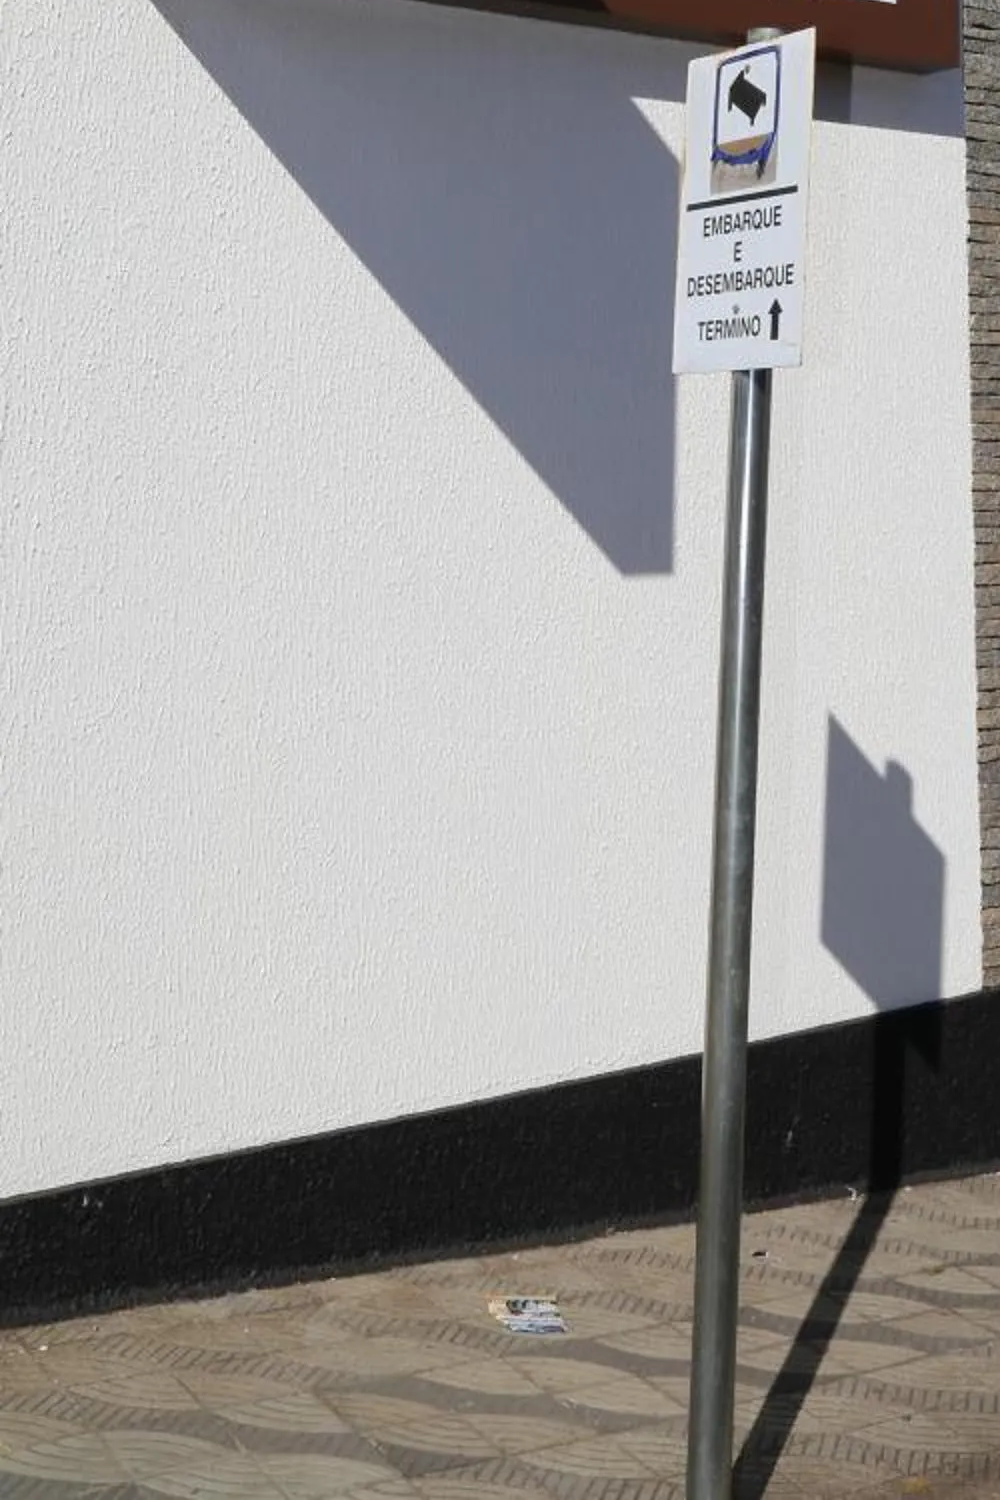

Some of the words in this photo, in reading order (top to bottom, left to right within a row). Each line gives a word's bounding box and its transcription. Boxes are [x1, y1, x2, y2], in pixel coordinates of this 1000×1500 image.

[702, 205, 783, 237] EMBARQUE
[733, 241, 743, 263] E
[686, 263, 795, 298] DESEMBARQUE
[697, 315, 762, 342] TERMINO
